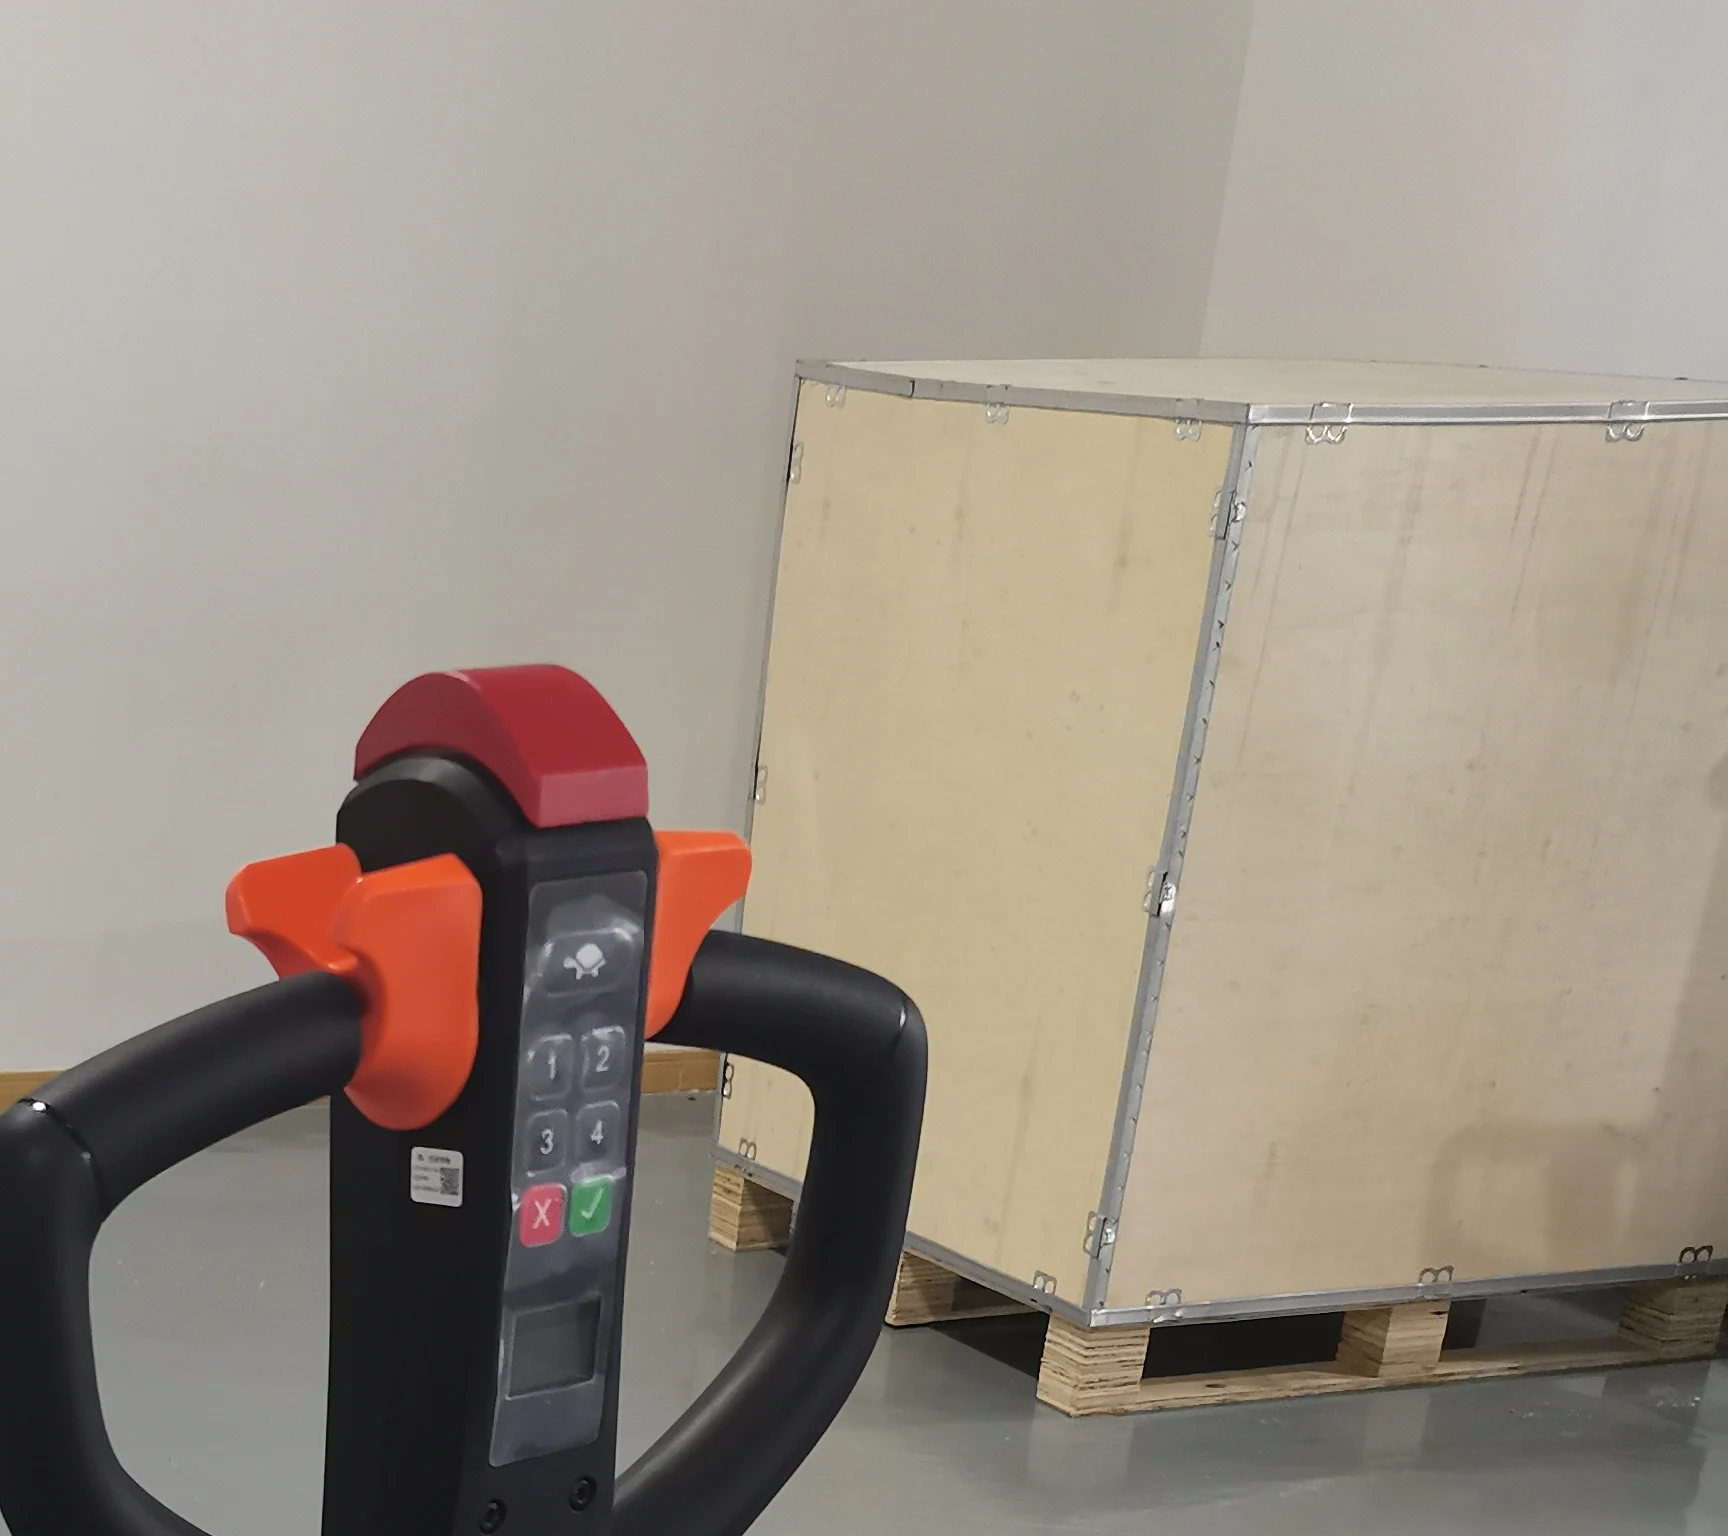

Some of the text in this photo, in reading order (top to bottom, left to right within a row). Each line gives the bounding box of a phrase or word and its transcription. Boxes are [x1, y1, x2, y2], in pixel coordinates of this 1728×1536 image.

[547, 1044, 610, 1080] 1 2
[539, 1119, 604, 1155] 3 4
